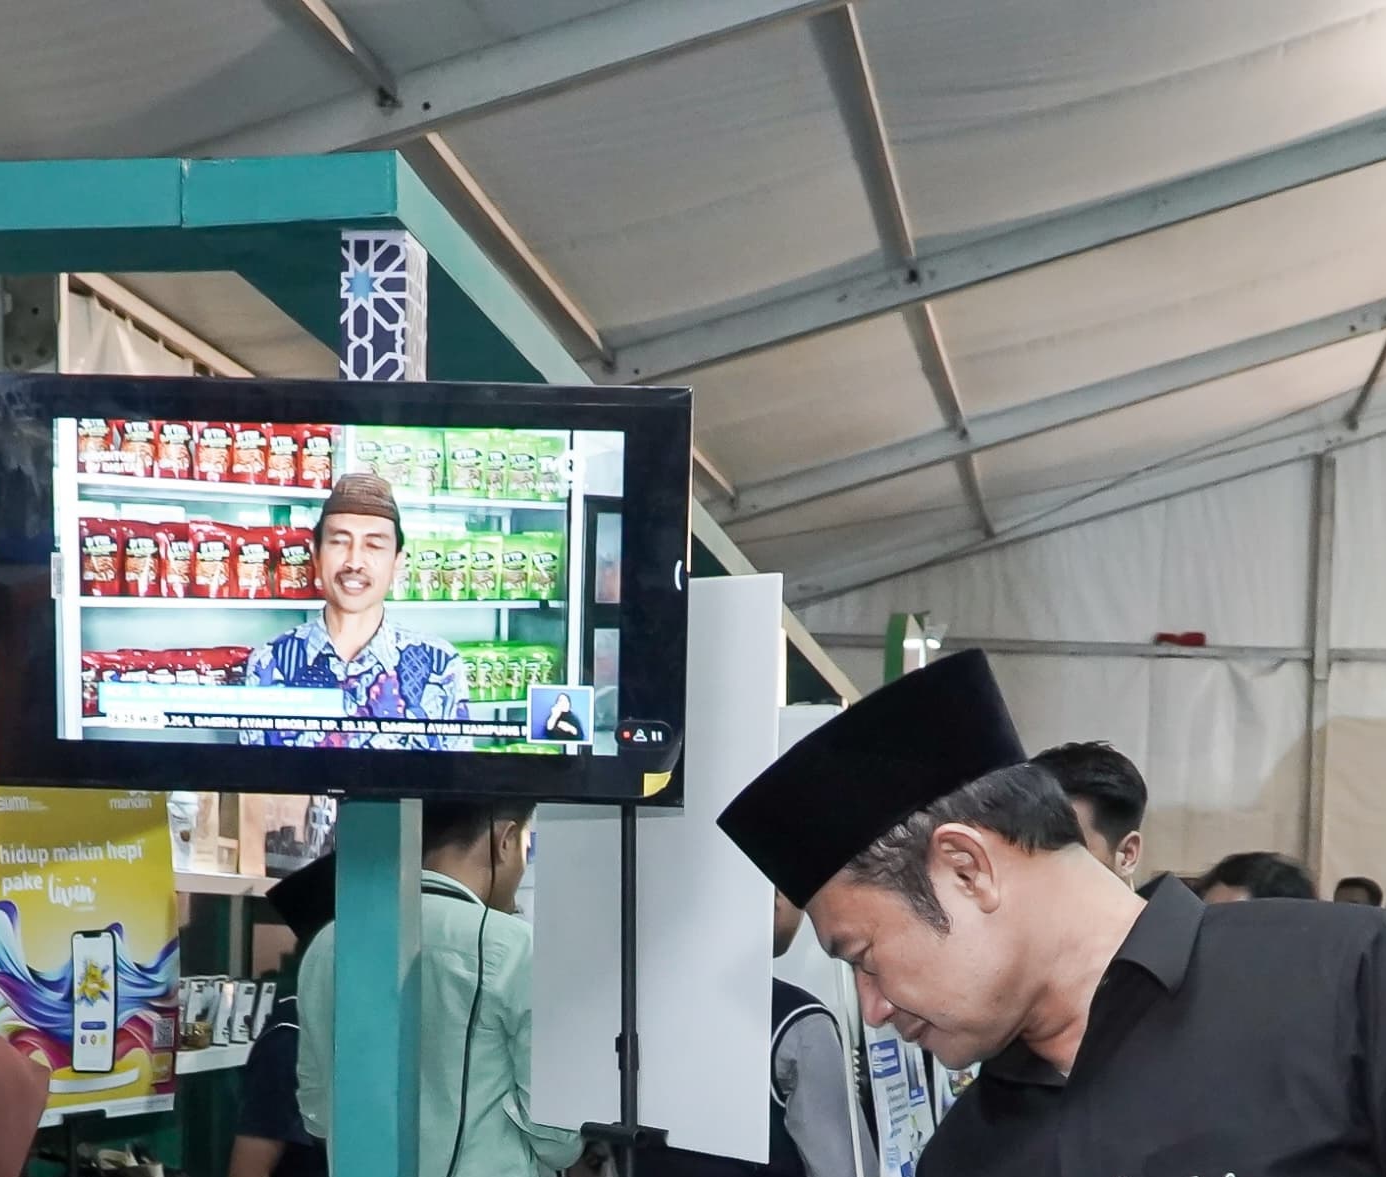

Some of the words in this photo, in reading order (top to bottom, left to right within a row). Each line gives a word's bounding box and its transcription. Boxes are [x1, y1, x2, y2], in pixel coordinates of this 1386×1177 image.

[240, 717, 274, 729] AYAM
[427, 722, 461, 734] AYAM
[53, 841, 104, 862] makin
[2, 871, 43, 897] pake
